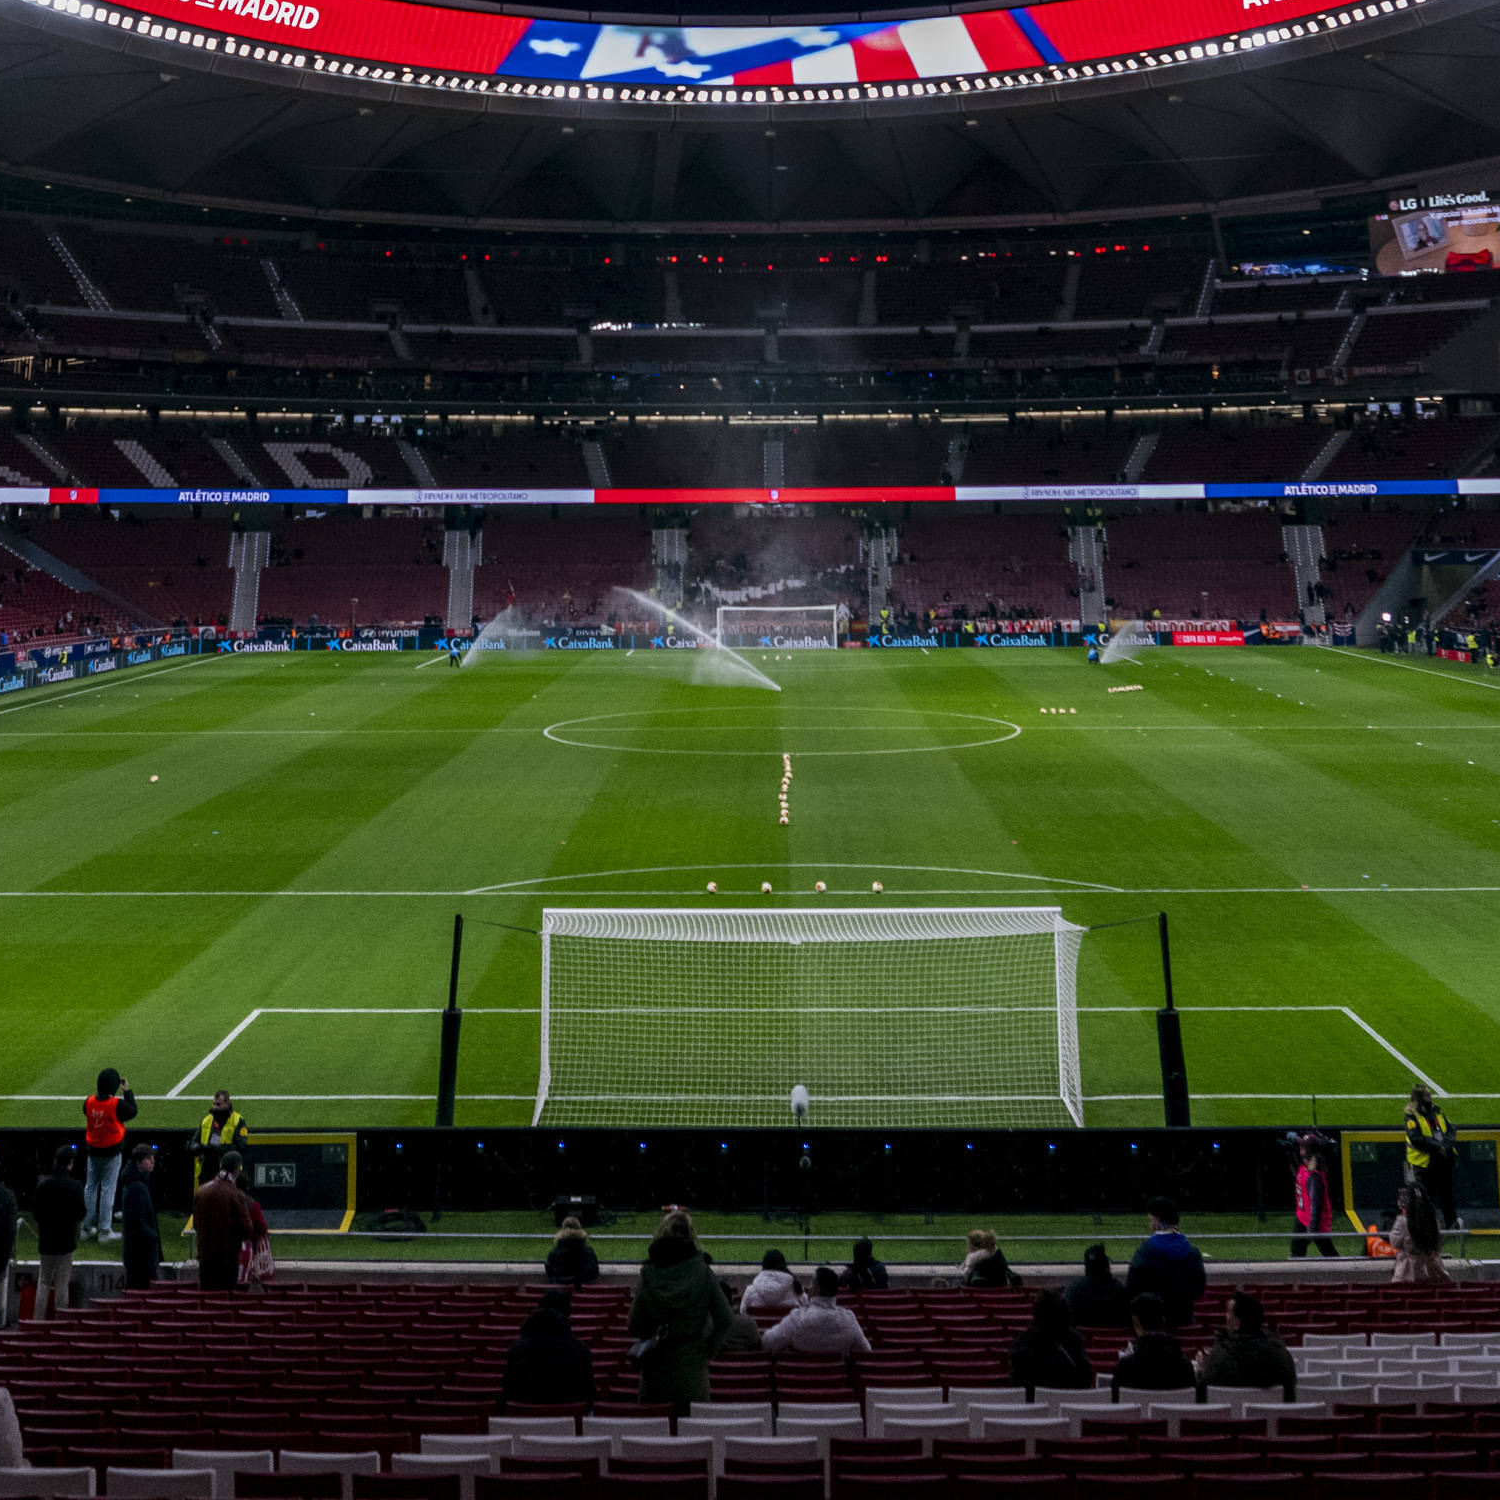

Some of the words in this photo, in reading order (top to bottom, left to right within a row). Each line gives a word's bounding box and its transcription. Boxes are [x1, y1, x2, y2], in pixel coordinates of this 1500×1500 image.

[1400, 198, 1417, 210] LG
[1284, 482, 1329, 495] ATLÉTICO
[1337, 483, 1377, 494] MADRID
[178, 490, 222, 502] ATLÉTICO
[231, 492, 270, 502] MADRID
[234, 639, 290, 652] CaixaBank
[343, 638, 398, 651] CaixaBank
[558, 636, 614, 649] CaixaBank
[773, 636, 830, 648] CaixaBank
[882, 634, 938, 647] CaixaBank
[990, 634, 1047, 646] CaixaBank
